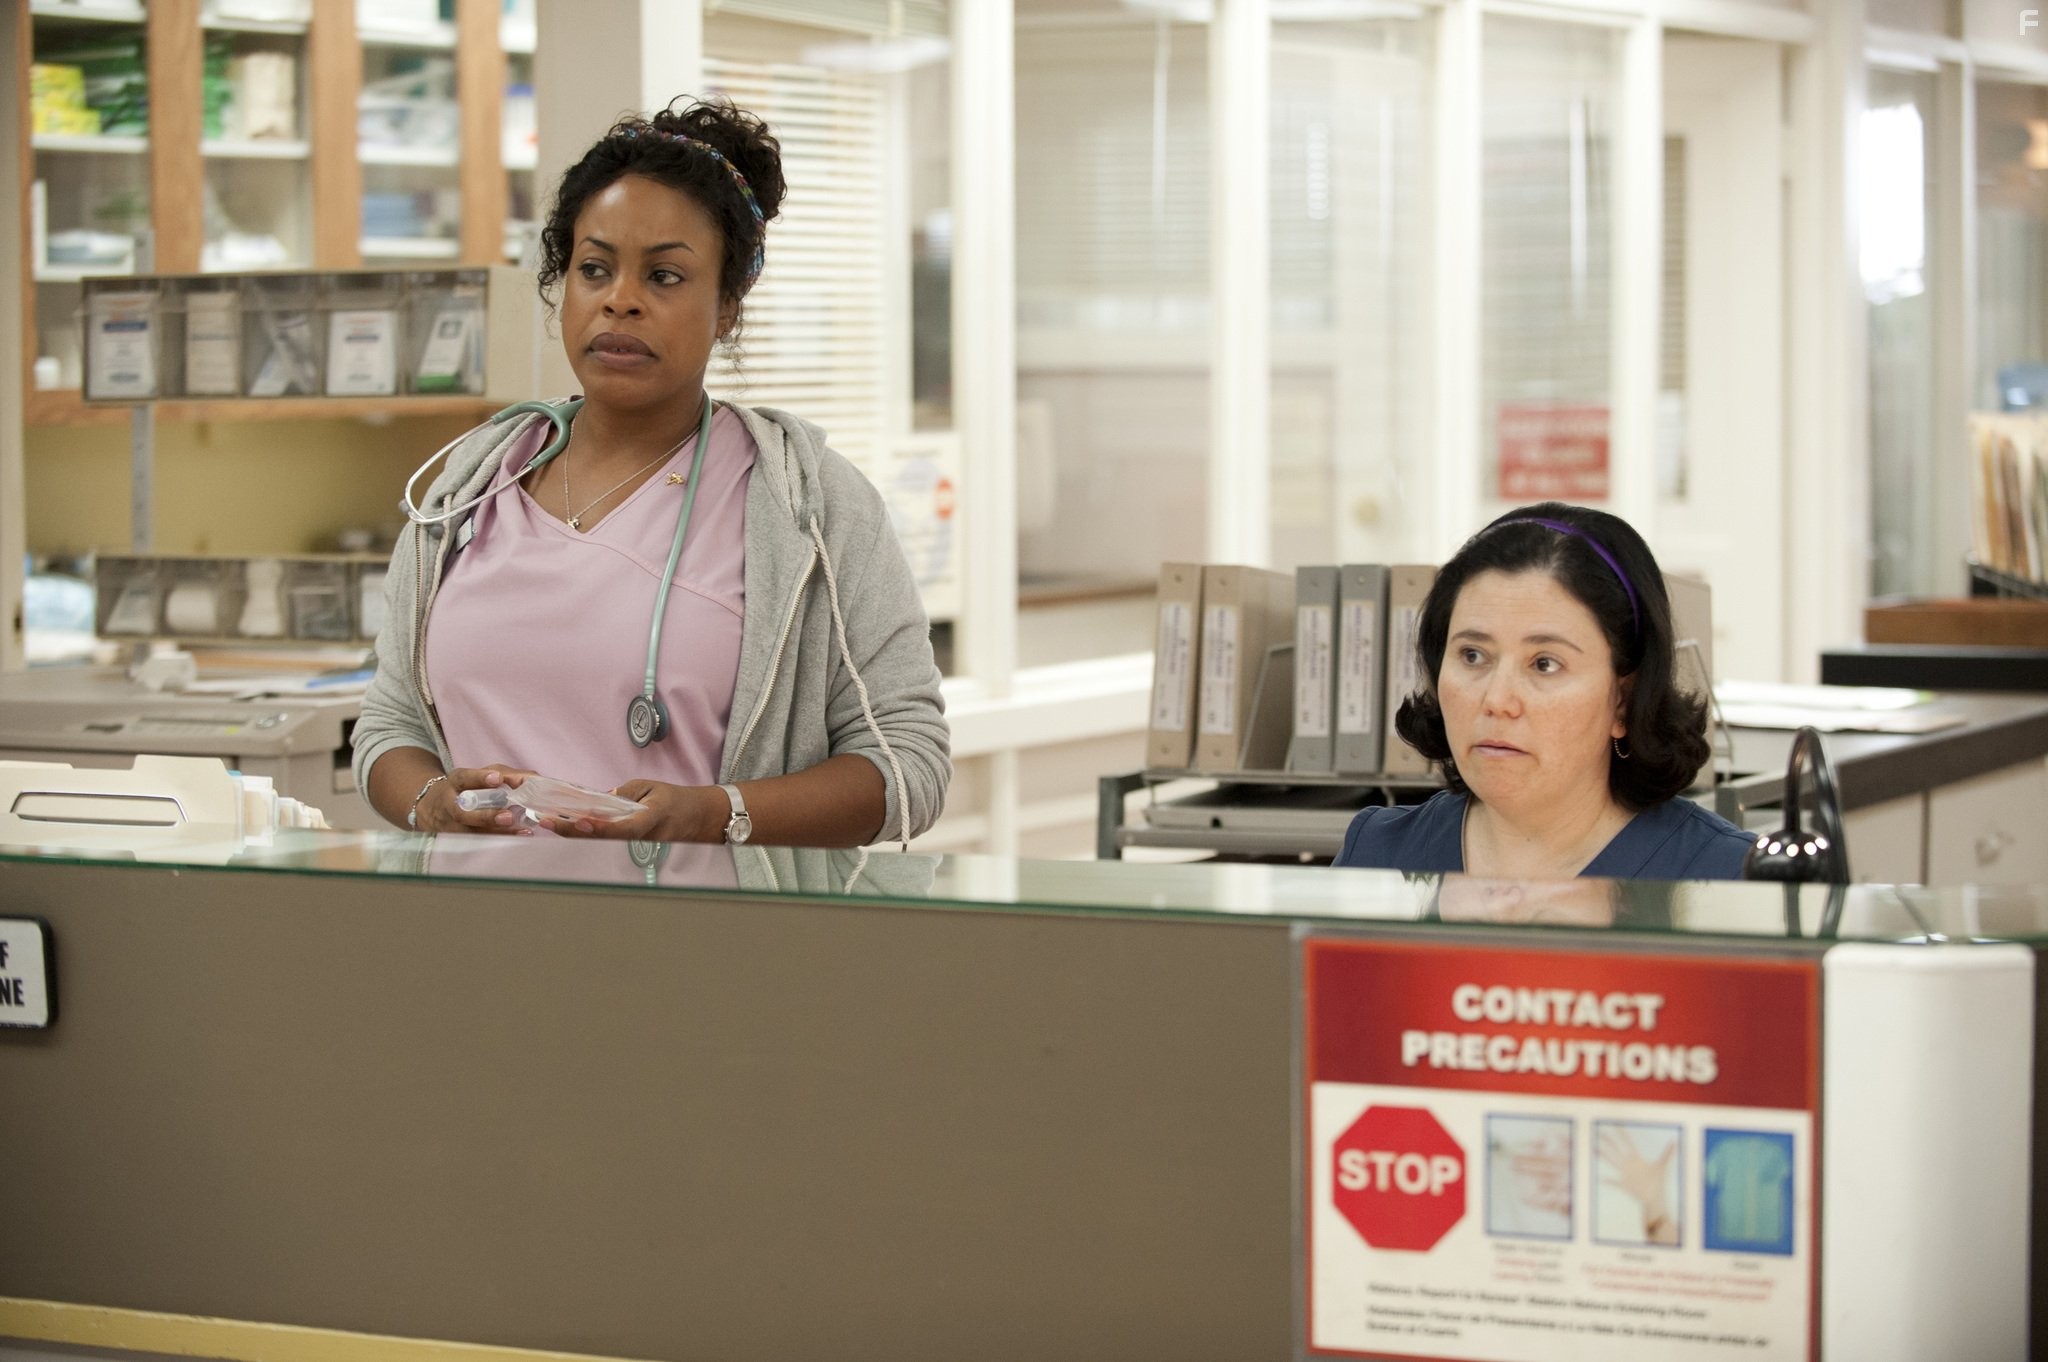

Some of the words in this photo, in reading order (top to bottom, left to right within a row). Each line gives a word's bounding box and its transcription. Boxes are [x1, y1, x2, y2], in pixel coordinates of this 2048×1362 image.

[1453, 984, 1662, 1029] CONTACT
[1402, 1031, 1717, 1083] PRECAUTIONS
[1339, 1150, 1462, 1195] STOP
